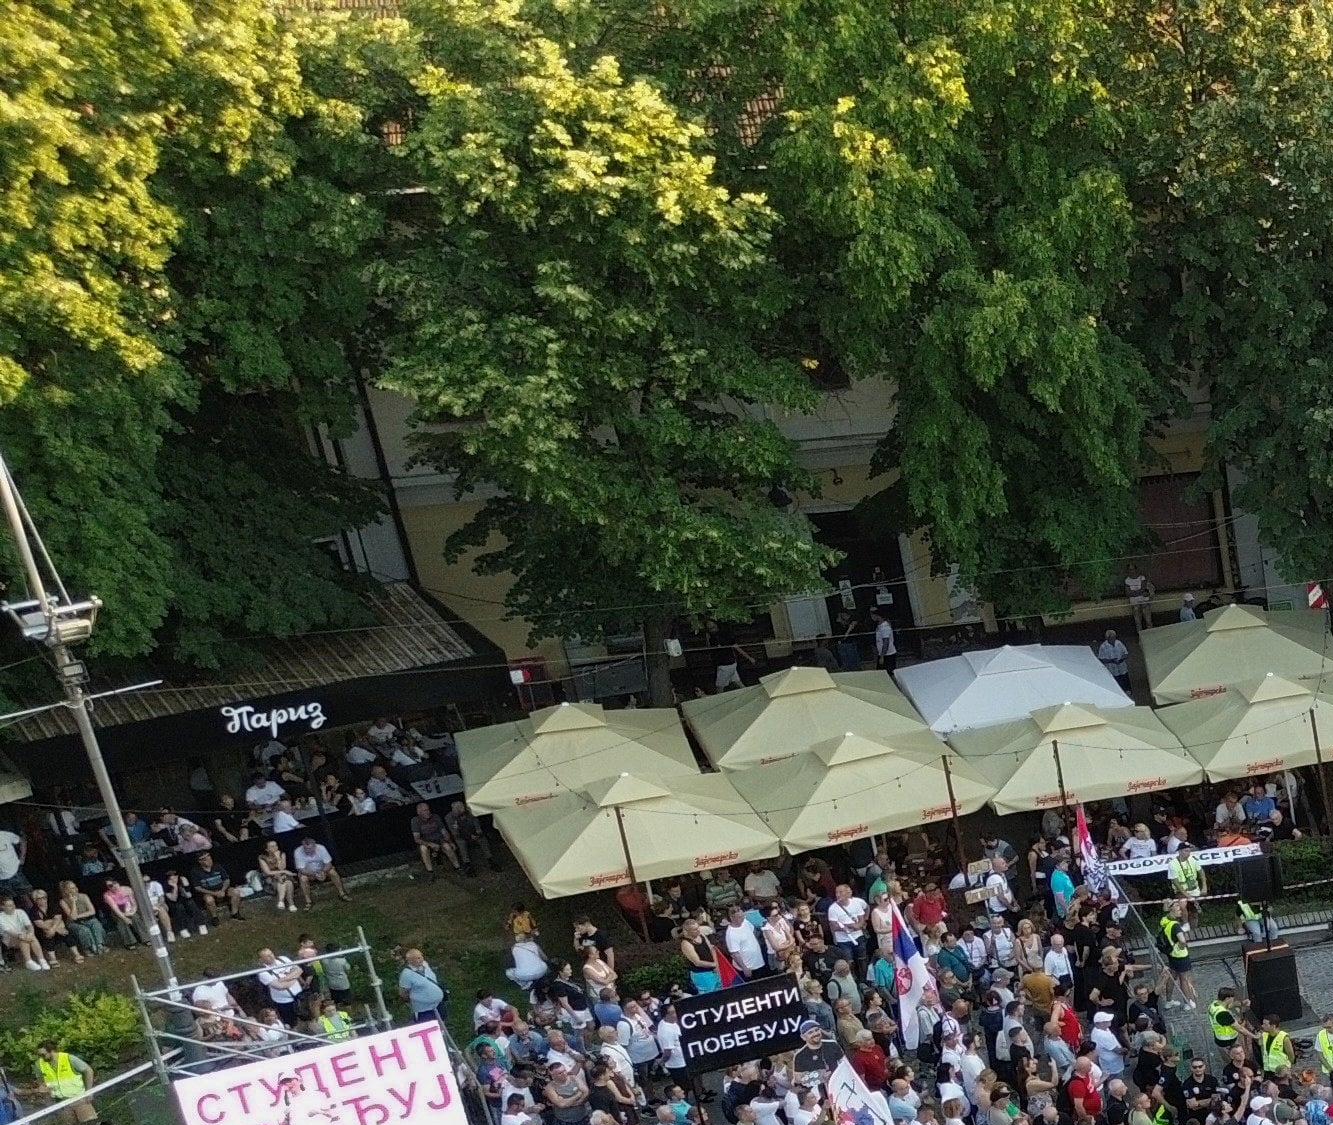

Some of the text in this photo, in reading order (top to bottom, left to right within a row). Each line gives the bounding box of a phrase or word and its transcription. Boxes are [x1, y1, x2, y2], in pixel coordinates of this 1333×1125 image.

[221, 702, 328, 739] Париз
[680, 987, 800, 1030] СТУДЕНТИ
[687, 1015, 802, 1058] ПОБЕЂУЈУ
